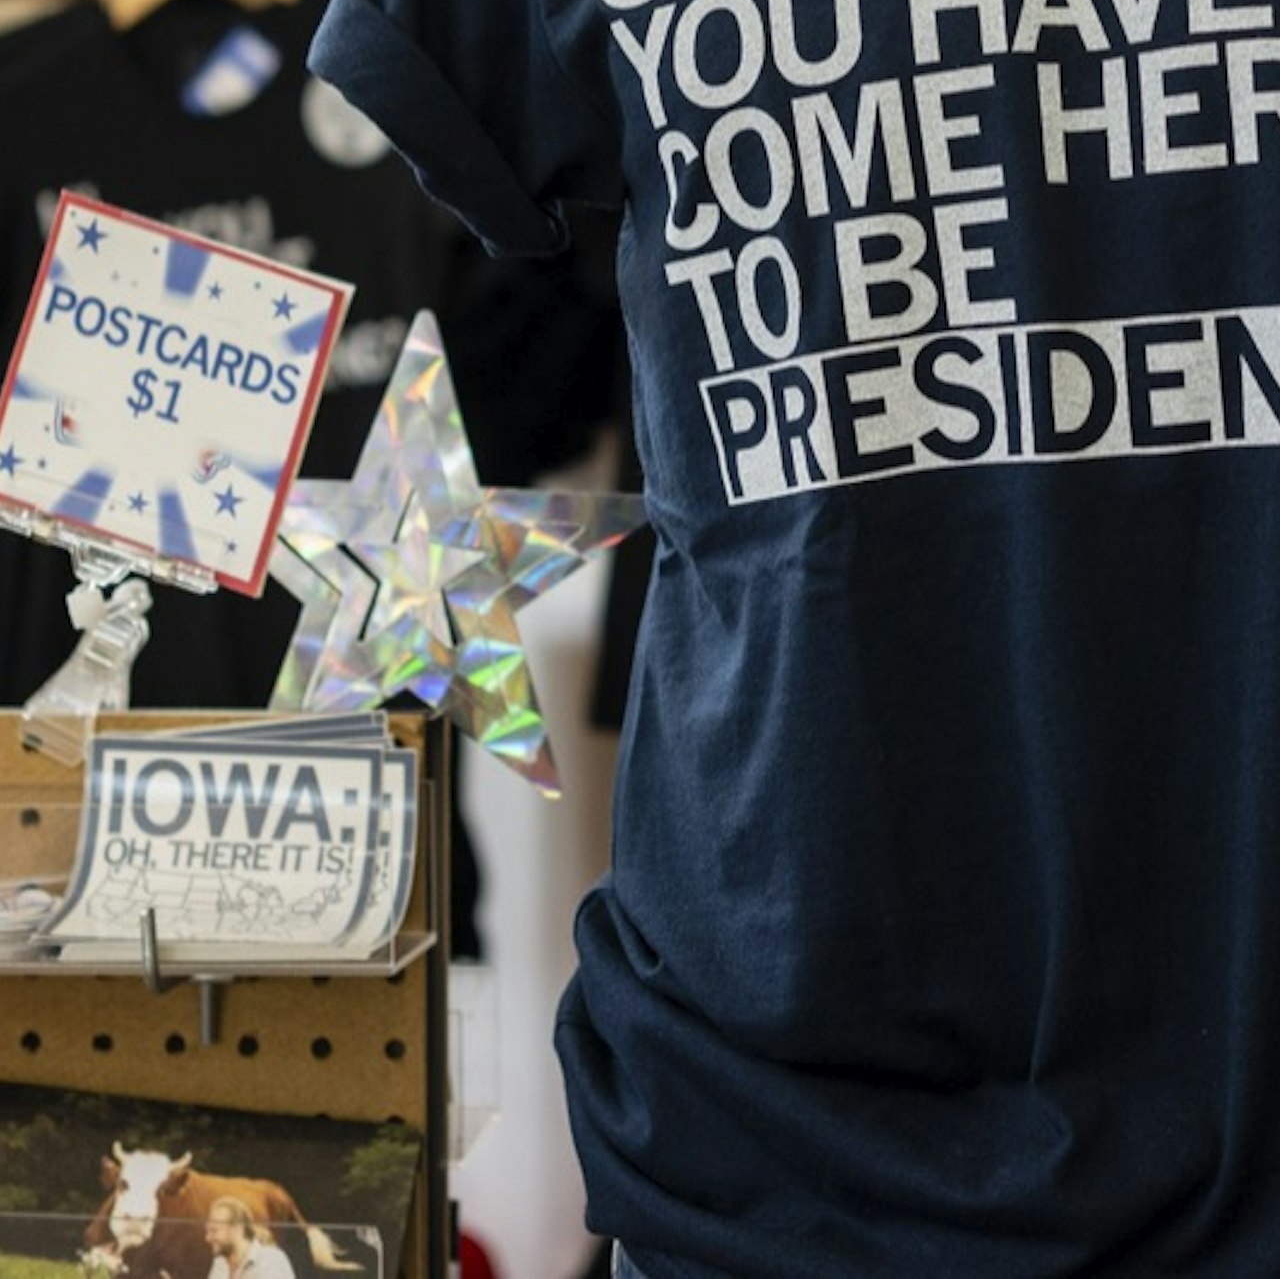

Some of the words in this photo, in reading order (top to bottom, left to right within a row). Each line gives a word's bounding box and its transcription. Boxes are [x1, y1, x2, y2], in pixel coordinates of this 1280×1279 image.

[662, 64, 1006, 252] COME
[664, 235, 802, 371] TO
[834, 197, 1018, 344] BE
[42, 285, 303, 405] POSTCARDS
[126, 369, 184, 423] $1
[107, 758, 358, 843] IOWA:
[103, 837, 156, 868] OH,
[169, 841, 272, 870] THERE
[280, 844, 309, 870] IT
